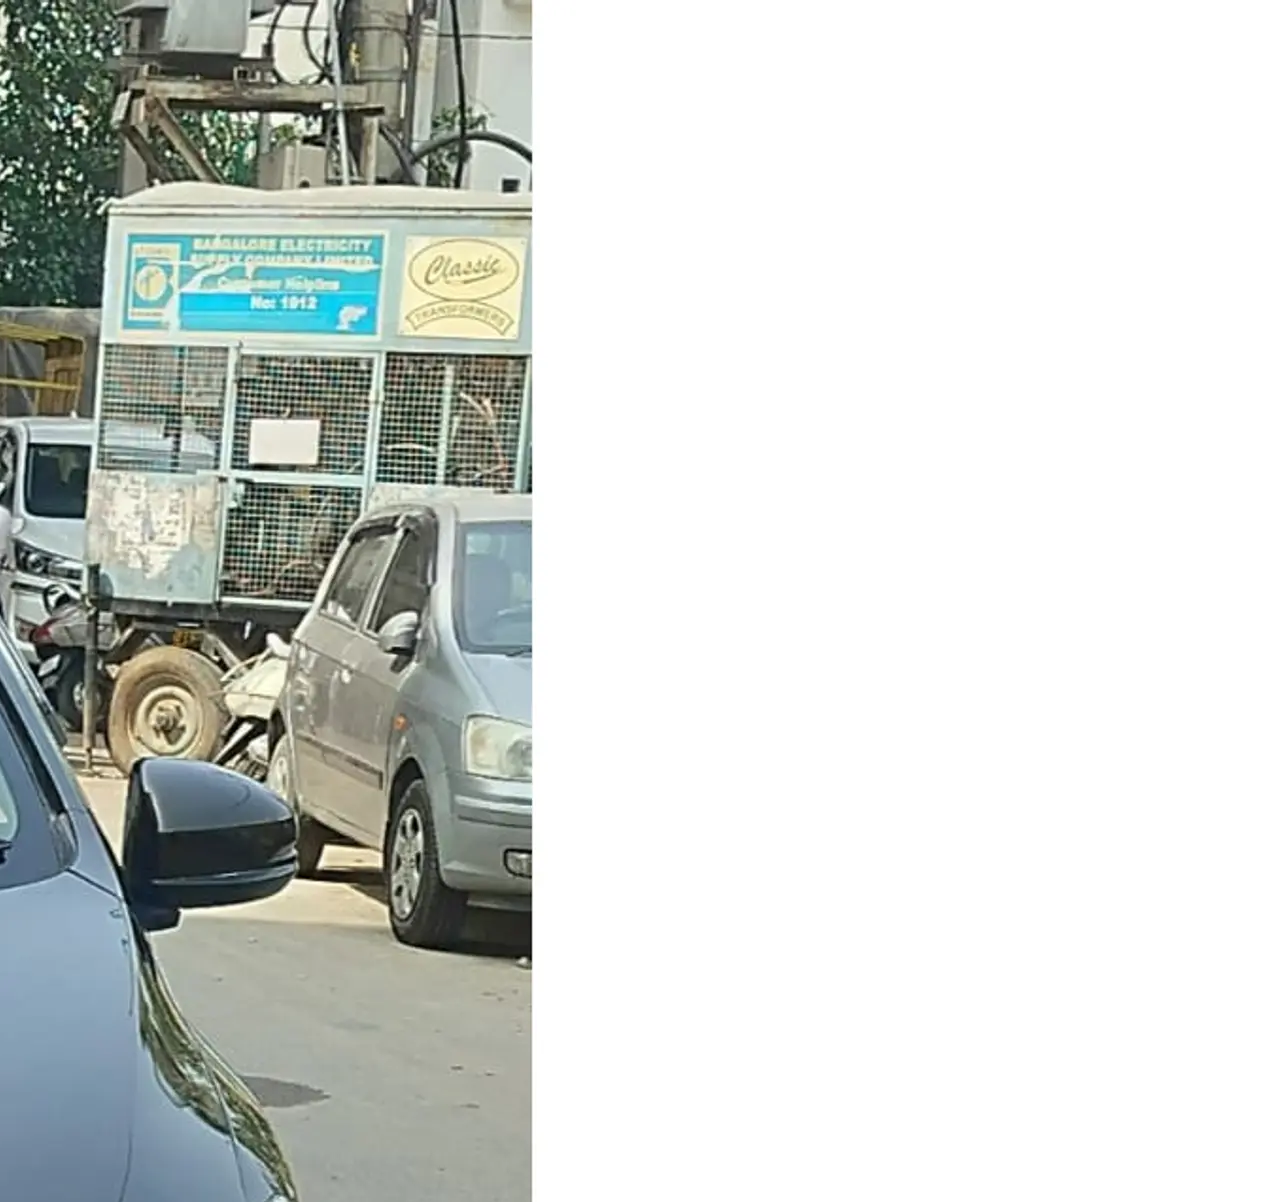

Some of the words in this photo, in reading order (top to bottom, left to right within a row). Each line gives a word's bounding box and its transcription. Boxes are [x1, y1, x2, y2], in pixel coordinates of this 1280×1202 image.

[193, 238, 277, 251] BANGALORE
[279, 238, 373, 252] ELECTRICITY
[424, 254, 503, 284] Classic
[280, 296, 317, 310] 1912
[414, 304, 505, 326] TRANSFORMERS
